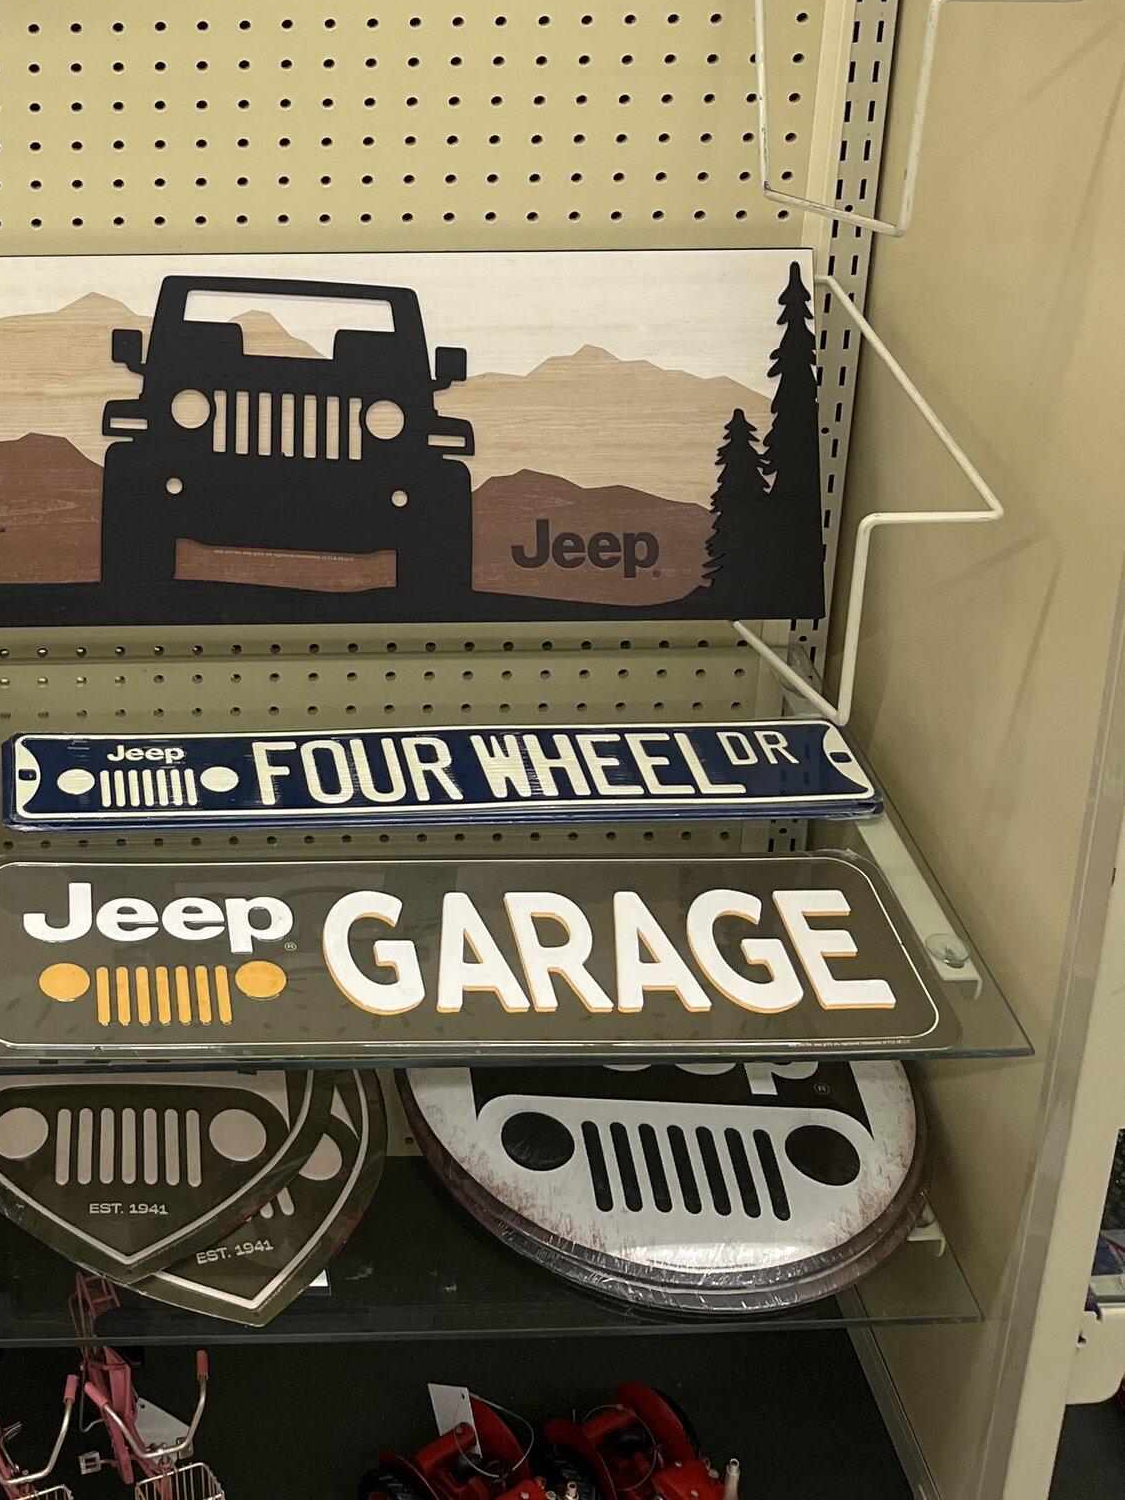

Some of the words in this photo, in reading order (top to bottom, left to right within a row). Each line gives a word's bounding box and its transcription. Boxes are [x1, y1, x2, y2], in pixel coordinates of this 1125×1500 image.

[511, 517, 655, 581] Jeep
[106, 742, 185, 765] Jeep
[251, 737, 465, 807] FOUR
[477, 730, 746, 802] WHEEL
[726, 730, 799, 766] DR
[22, 883, 293, 955] Jeep
[322, 889, 897, 1016] GARAGE
[89, 1203, 124, 1215] EST.
[129, 1203, 169, 1215] 1941
[195, 1246, 233, 1266] EST.
[234, 1238, 274, 1257] 1941
